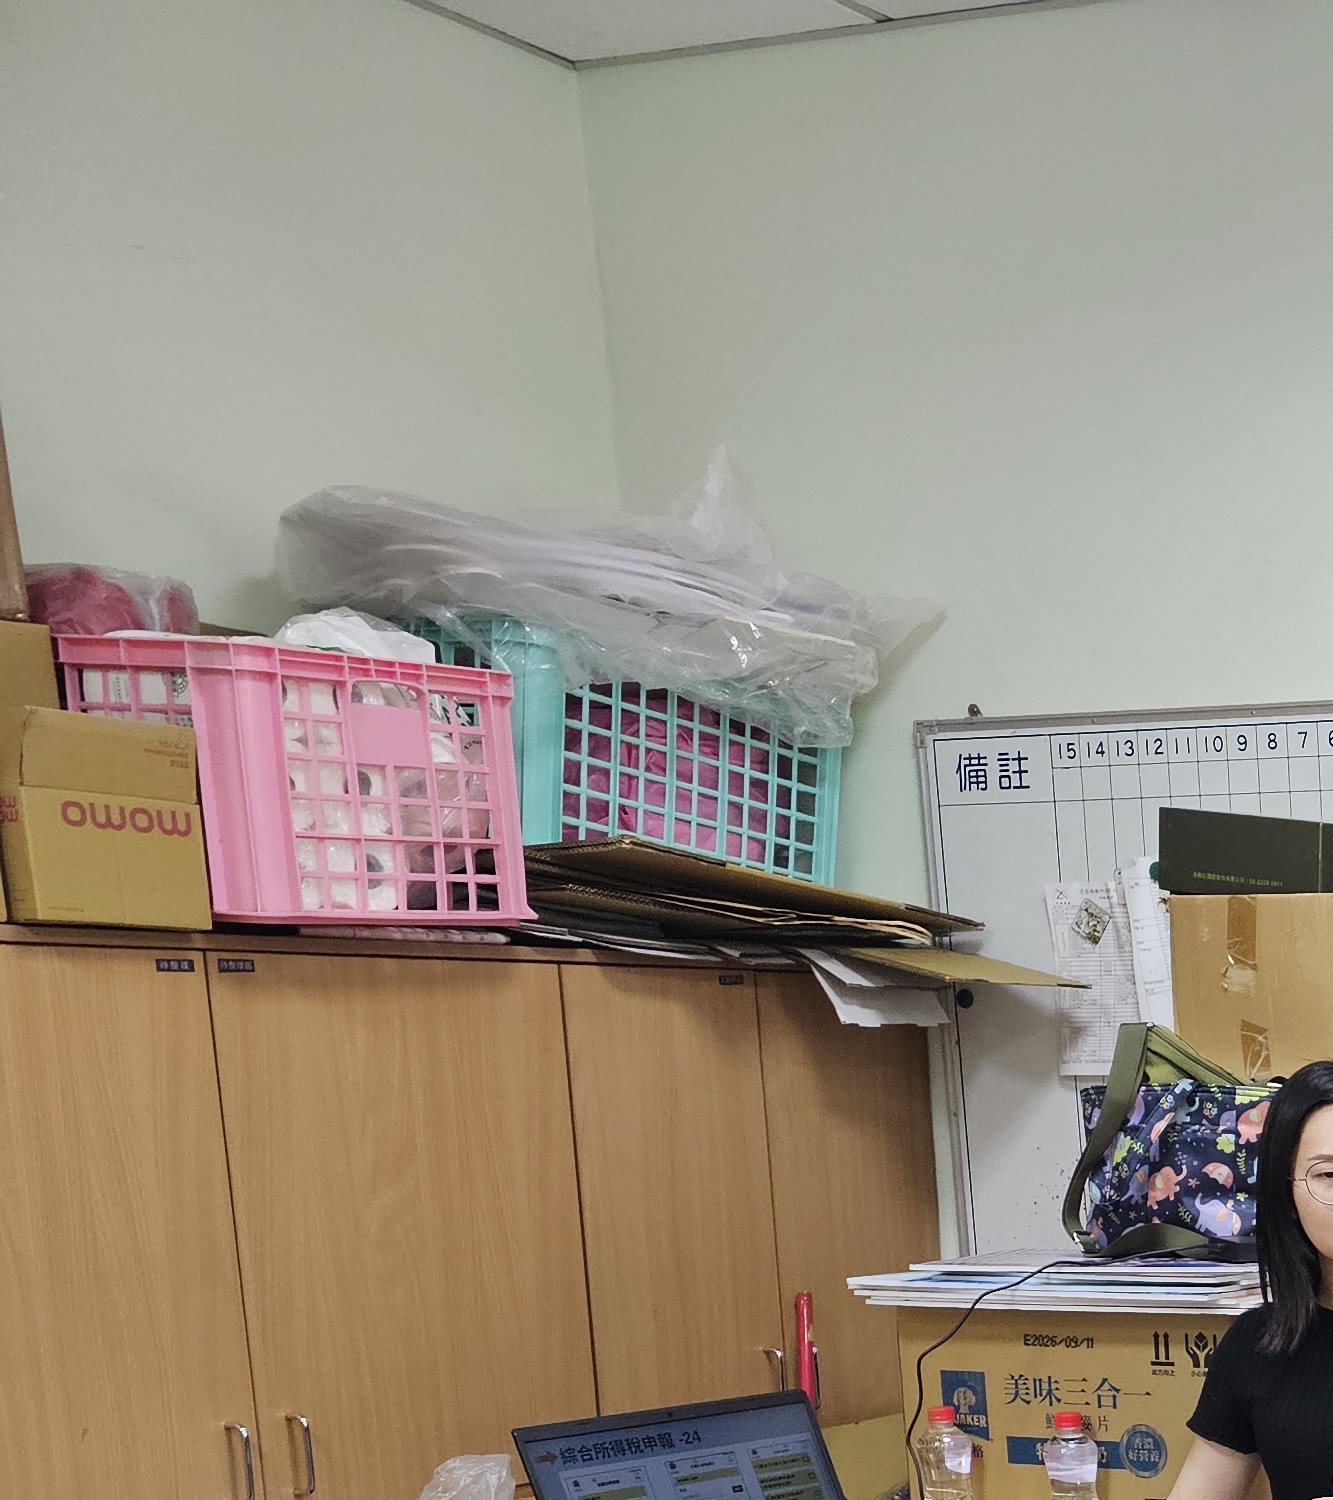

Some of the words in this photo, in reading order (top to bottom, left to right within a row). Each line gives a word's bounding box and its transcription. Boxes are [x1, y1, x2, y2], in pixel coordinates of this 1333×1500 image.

[1058, 742, 1077, 760] 15
[1087, 741, 1105, 758] 14
[1116, 740, 1135, 757] 13
[1145, 738, 1164, 756] 12
[1174, 737, 1192, 754] 11
[1204, 735, 1224, 753] 10
[1237, 734, 1248, 752] 9
[1267, 732, 1278, 750] 8
[1297, 731, 1308, 748] 7
[955, 750, 1030, 792] 備註
[61, 800, 192, 837] momo
[1003, 1372, 1152, 1410] 美味三合一
[954, 1412, 987, 1428] UAKER
[559, 1432, 676, 1465] 綜合所得稅申報
